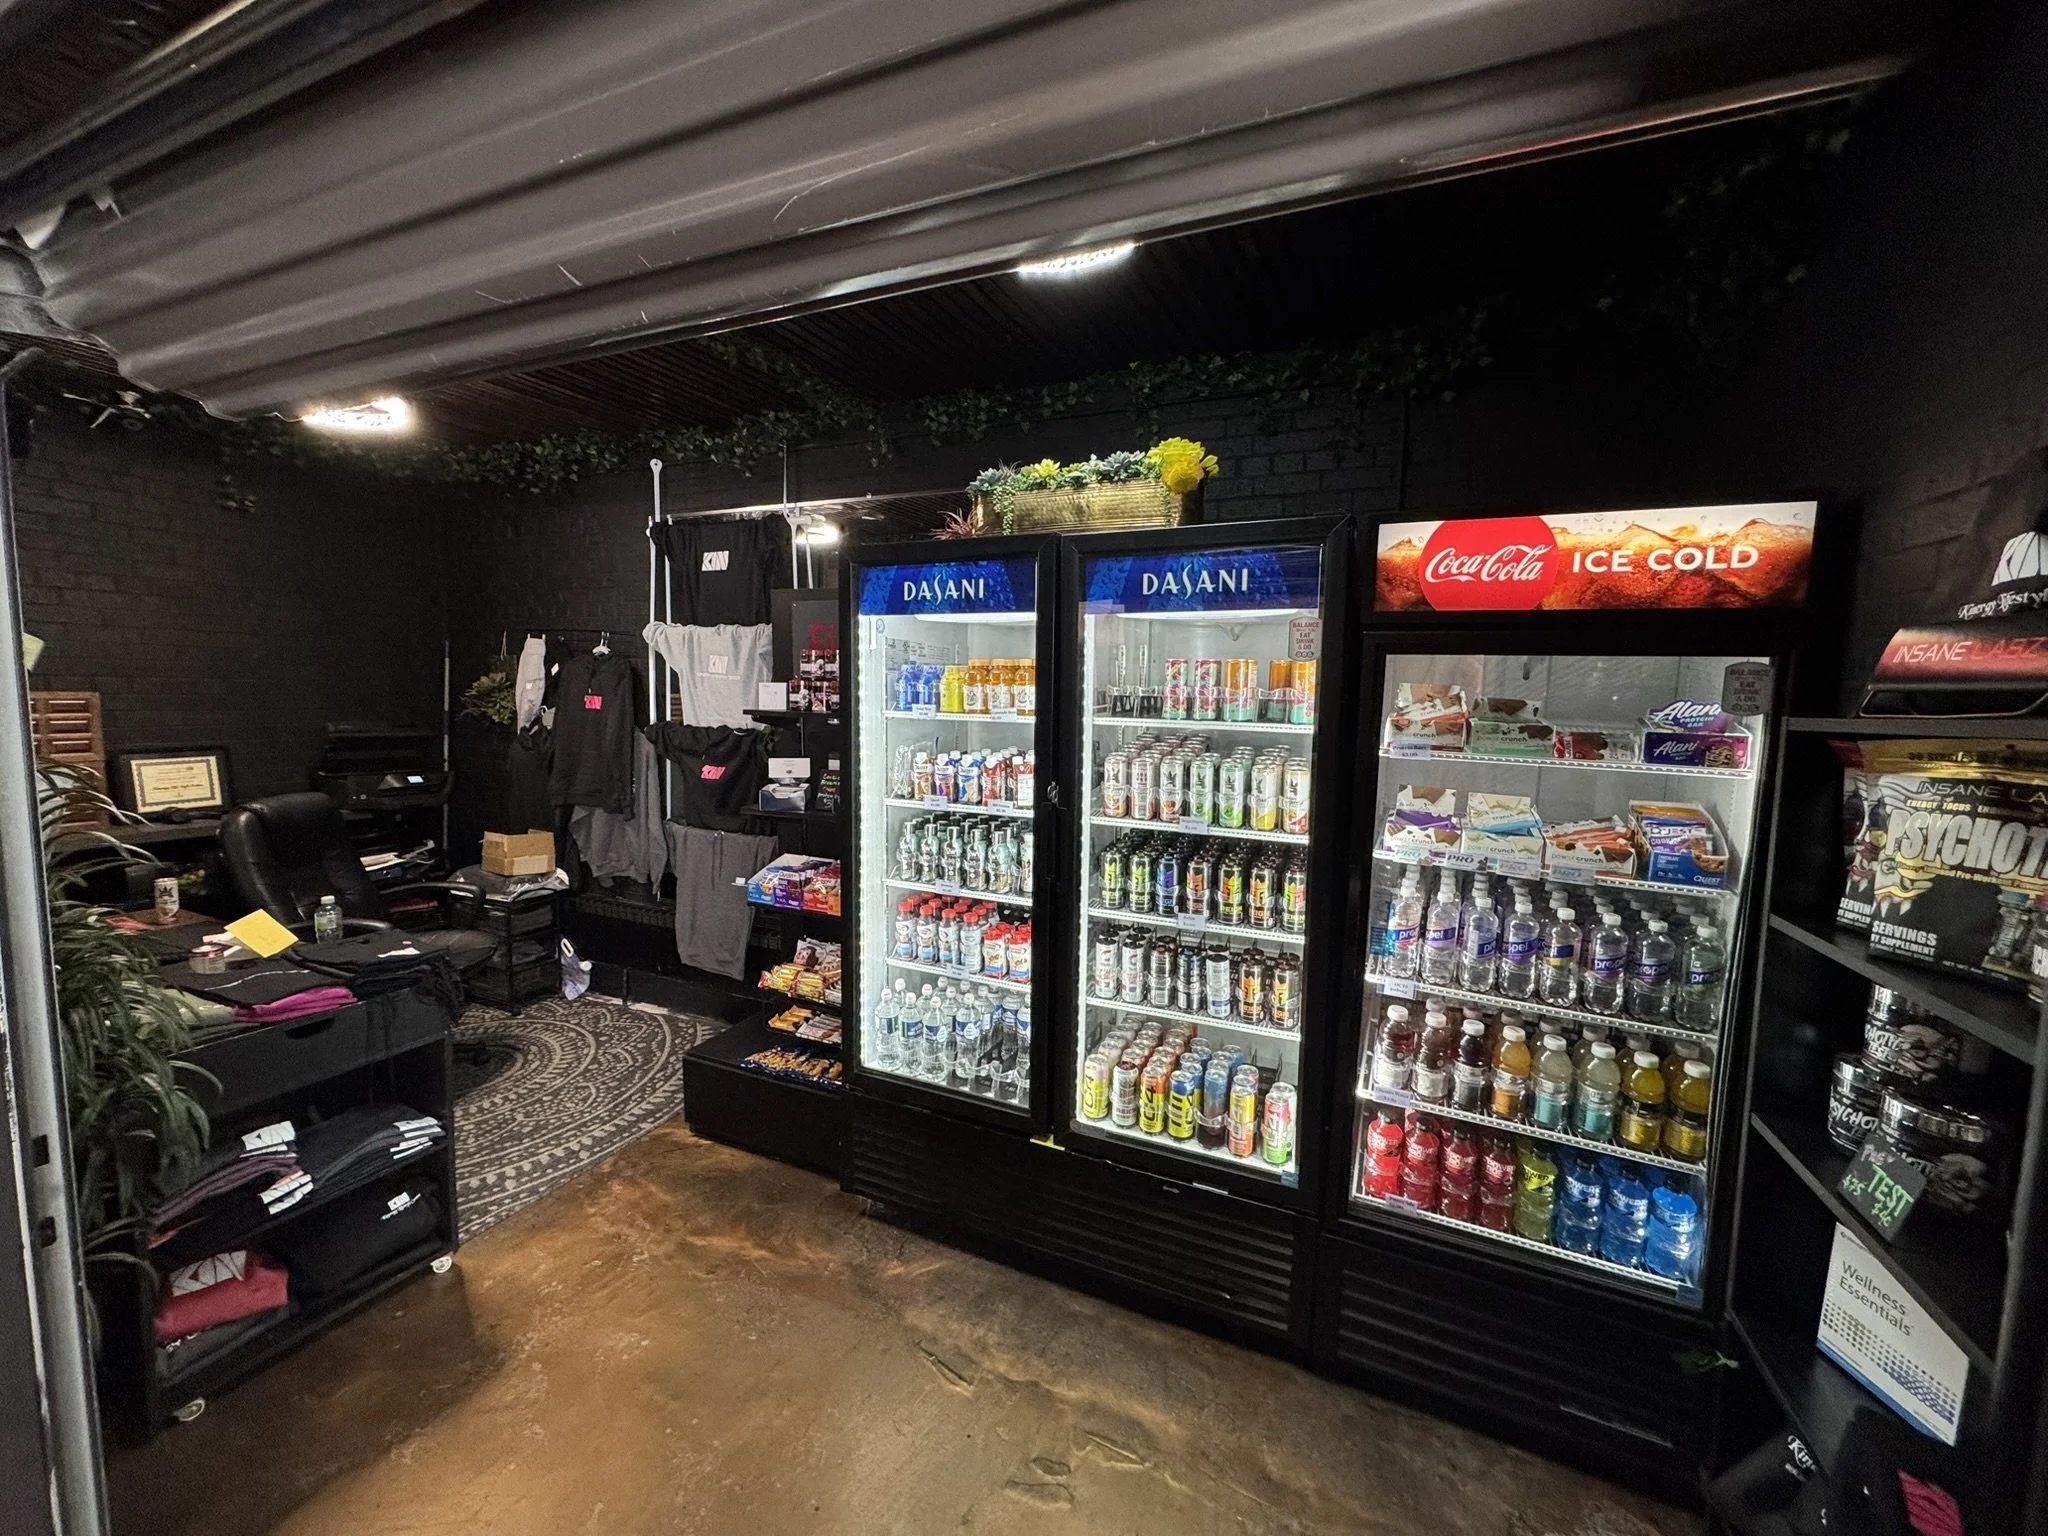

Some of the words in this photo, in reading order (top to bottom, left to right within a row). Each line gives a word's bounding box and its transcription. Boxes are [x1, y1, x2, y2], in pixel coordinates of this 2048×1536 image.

[1424, 543, 1554, 583] Coca-Cola
[1572, 550, 1633, 573] ICE
[1647, 546, 1759, 572] COLD
[904, 574, 984, 605] DASANI
[1142, 564, 1249, 600] DASANI
[1893, 642, 1972, 663] INSANE
[1653, 701, 1721, 723] Alan
[1653, 740, 1700, 757] Alani
[1917, 781, 2004, 798] INSANE
[1942, 802, 1972, 812] FOCUS
[1395, 849, 1421, 858] PRO
[1447, 853, 1474, 864] PRO
[1490, 847, 1516, 855] crunch
[1576, 855, 1604, 864] crunch
[1693, 875, 1721, 885] QUEST
[1839, 897, 1872, 915] SERVIN
[1872, 920, 1938, 947] SERVINGS
[1880, 936, 1937, 956] SUPPLEMENT
[1144, 1086, 1157, 1122] C4
[1867, 1163, 1915, 1217] TEST
[1842, 1260, 1906, 1316] Wellness
[1839, 1276, 1912, 1336] Essentials
